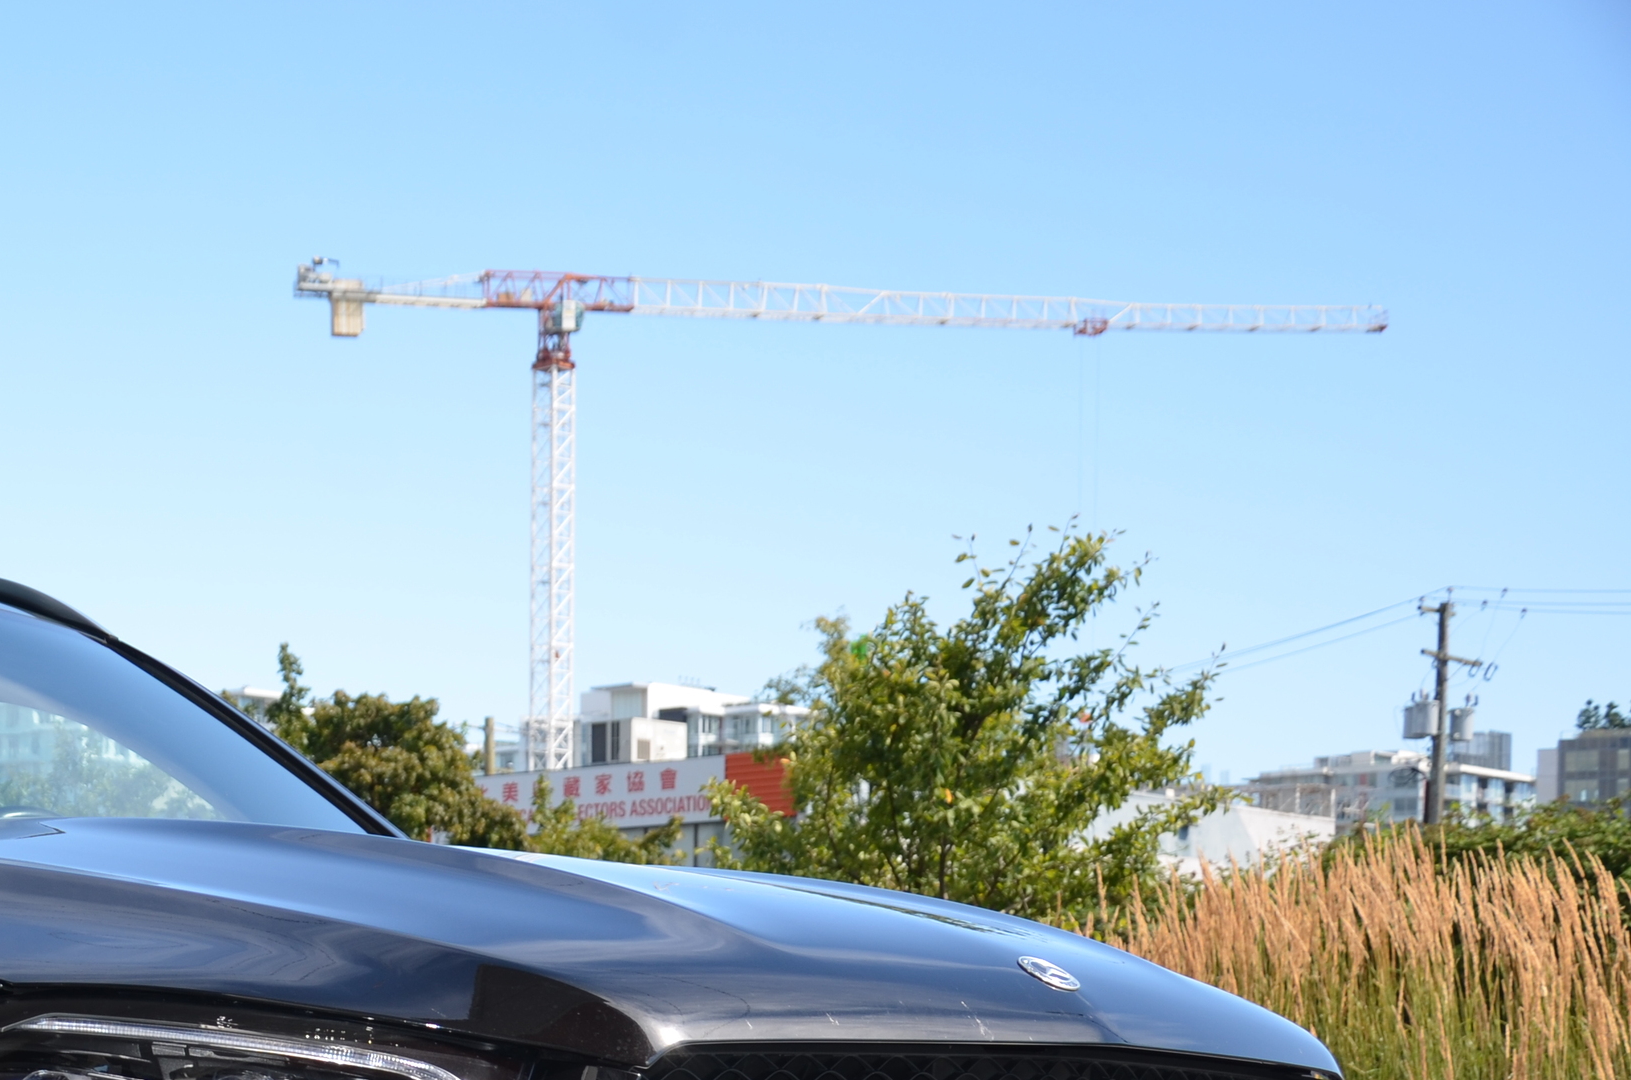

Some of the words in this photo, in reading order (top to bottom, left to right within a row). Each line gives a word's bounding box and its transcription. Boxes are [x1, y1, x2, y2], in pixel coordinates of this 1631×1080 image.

[480, 766, 679, 803] 美藏家協會
